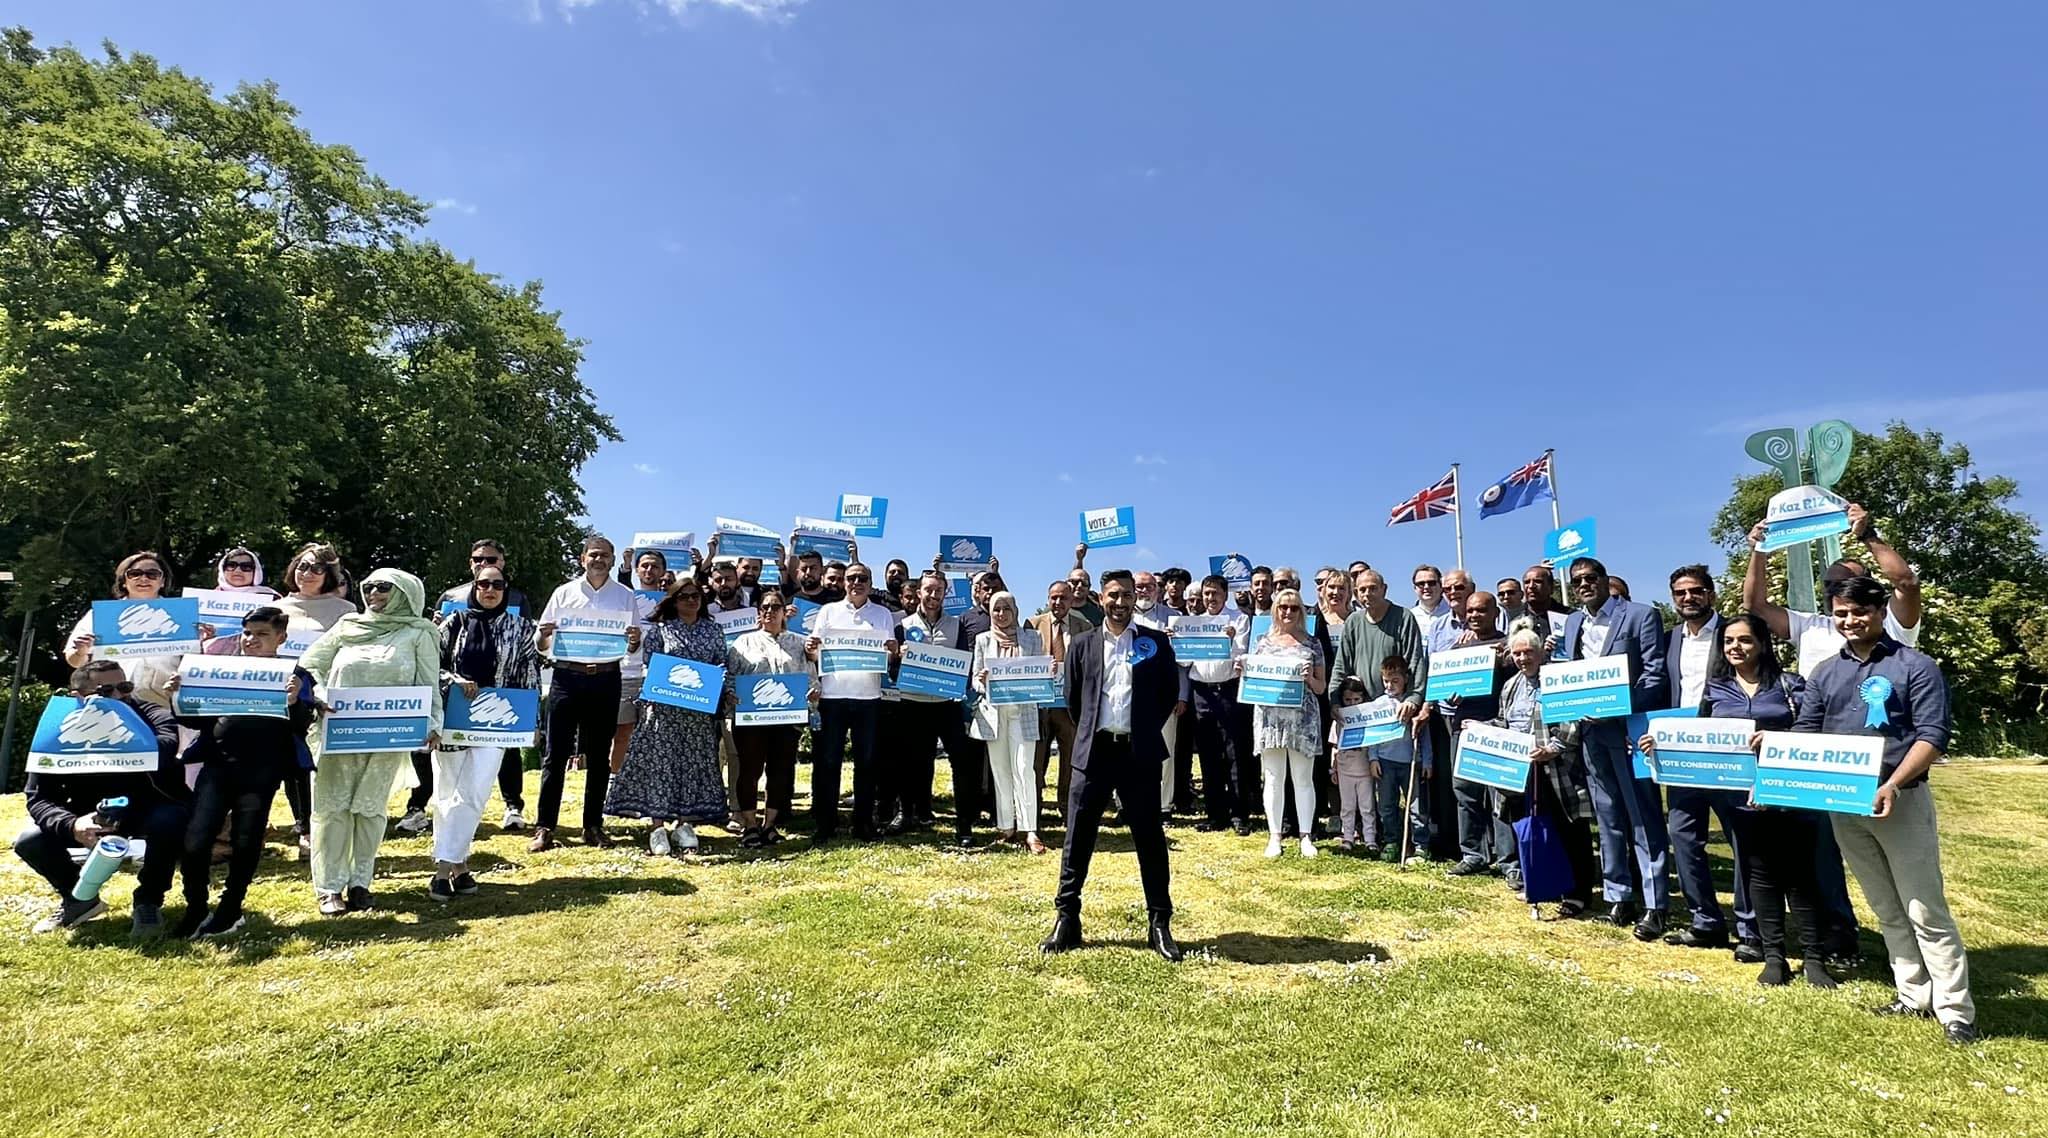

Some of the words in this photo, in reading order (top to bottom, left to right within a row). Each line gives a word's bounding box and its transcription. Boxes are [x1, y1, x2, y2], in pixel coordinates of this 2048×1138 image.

[844, 504, 861, 514] VOTE
[1780, 502, 1800, 512] Kaz
[1088, 518, 1106, 529] VOTE
[207, 600, 230, 610] Kaz
[560, 618, 572, 626] Dr
[576, 618, 594, 626] Kaz
[598, 619, 626, 630] RIZVI
[734, 616, 756, 627] RIZVI
[1185, 624, 1200, 632] Kaz
[284, 640, 308, 651] Kaz
[858, 638, 882, 647] RIZVI
[122, 644, 190, 654] Conservatives
[906, 651, 918, 660] Dr
[920, 653, 938, 664] Kaz
[940, 656, 966, 670] RIZVI
[1433, 662, 1442, 670] Dr
[1444, 660, 1461, 669] Kaz
[1464, 656, 1489, 666] RIZVI
[992, 667, 1004, 675] Dr
[1006, 666, 1022, 675] Kaz
[1024, 666, 1048, 674] RIZVI
[1246, 664, 1254, 672] Dr
[1256, 664, 1274, 673] Kaz
[188, 667, 206, 678] Dr
[210, 668, 238, 680] Kaz
[242, 670, 284, 682] RIZVI
[1545, 676, 1558, 686] Dr
[1562, 674, 1584, 684] Kaz
[1586, 667, 1620, 681] RIZVI
[182, 696, 206, 704] VOTE
[652, 686, 710, 704] Conservatives
[334, 700, 351, 710] Dr
[354, 700, 380, 710] Kaz
[384, 699, 422, 710] RIZVI
[1345, 716, 1356, 724] Dr
[1356, 714, 1373, 722] Kaz
[354, 726, 414, 734] CONSERVATIVE
[468, 734, 526, 743] Conservatives
[1657, 731, 1674, 742] Dr
[1676, 731, 1702, 744] Kaz
[1706, 732, 1746, 745] RIZVI
[1467, 733, 1478, 744] Dr
[1480, 736, 1500, 748] Kaz
[1502, 740, 1528, 756] RIZVI
[1766, 746, 1785, 758] Dr
[1788, 748, 1819, 762] Kaz
[1822, 750, 1870, 766] RIZVI
[57, 759, 144, 768] Conservatives
[1680, 760, 1742, 771] CONSERVATIVE
[1761, 778, 1784, 787] VOTE
[1786, 780, 1858, 794] CONSERVATIVE
